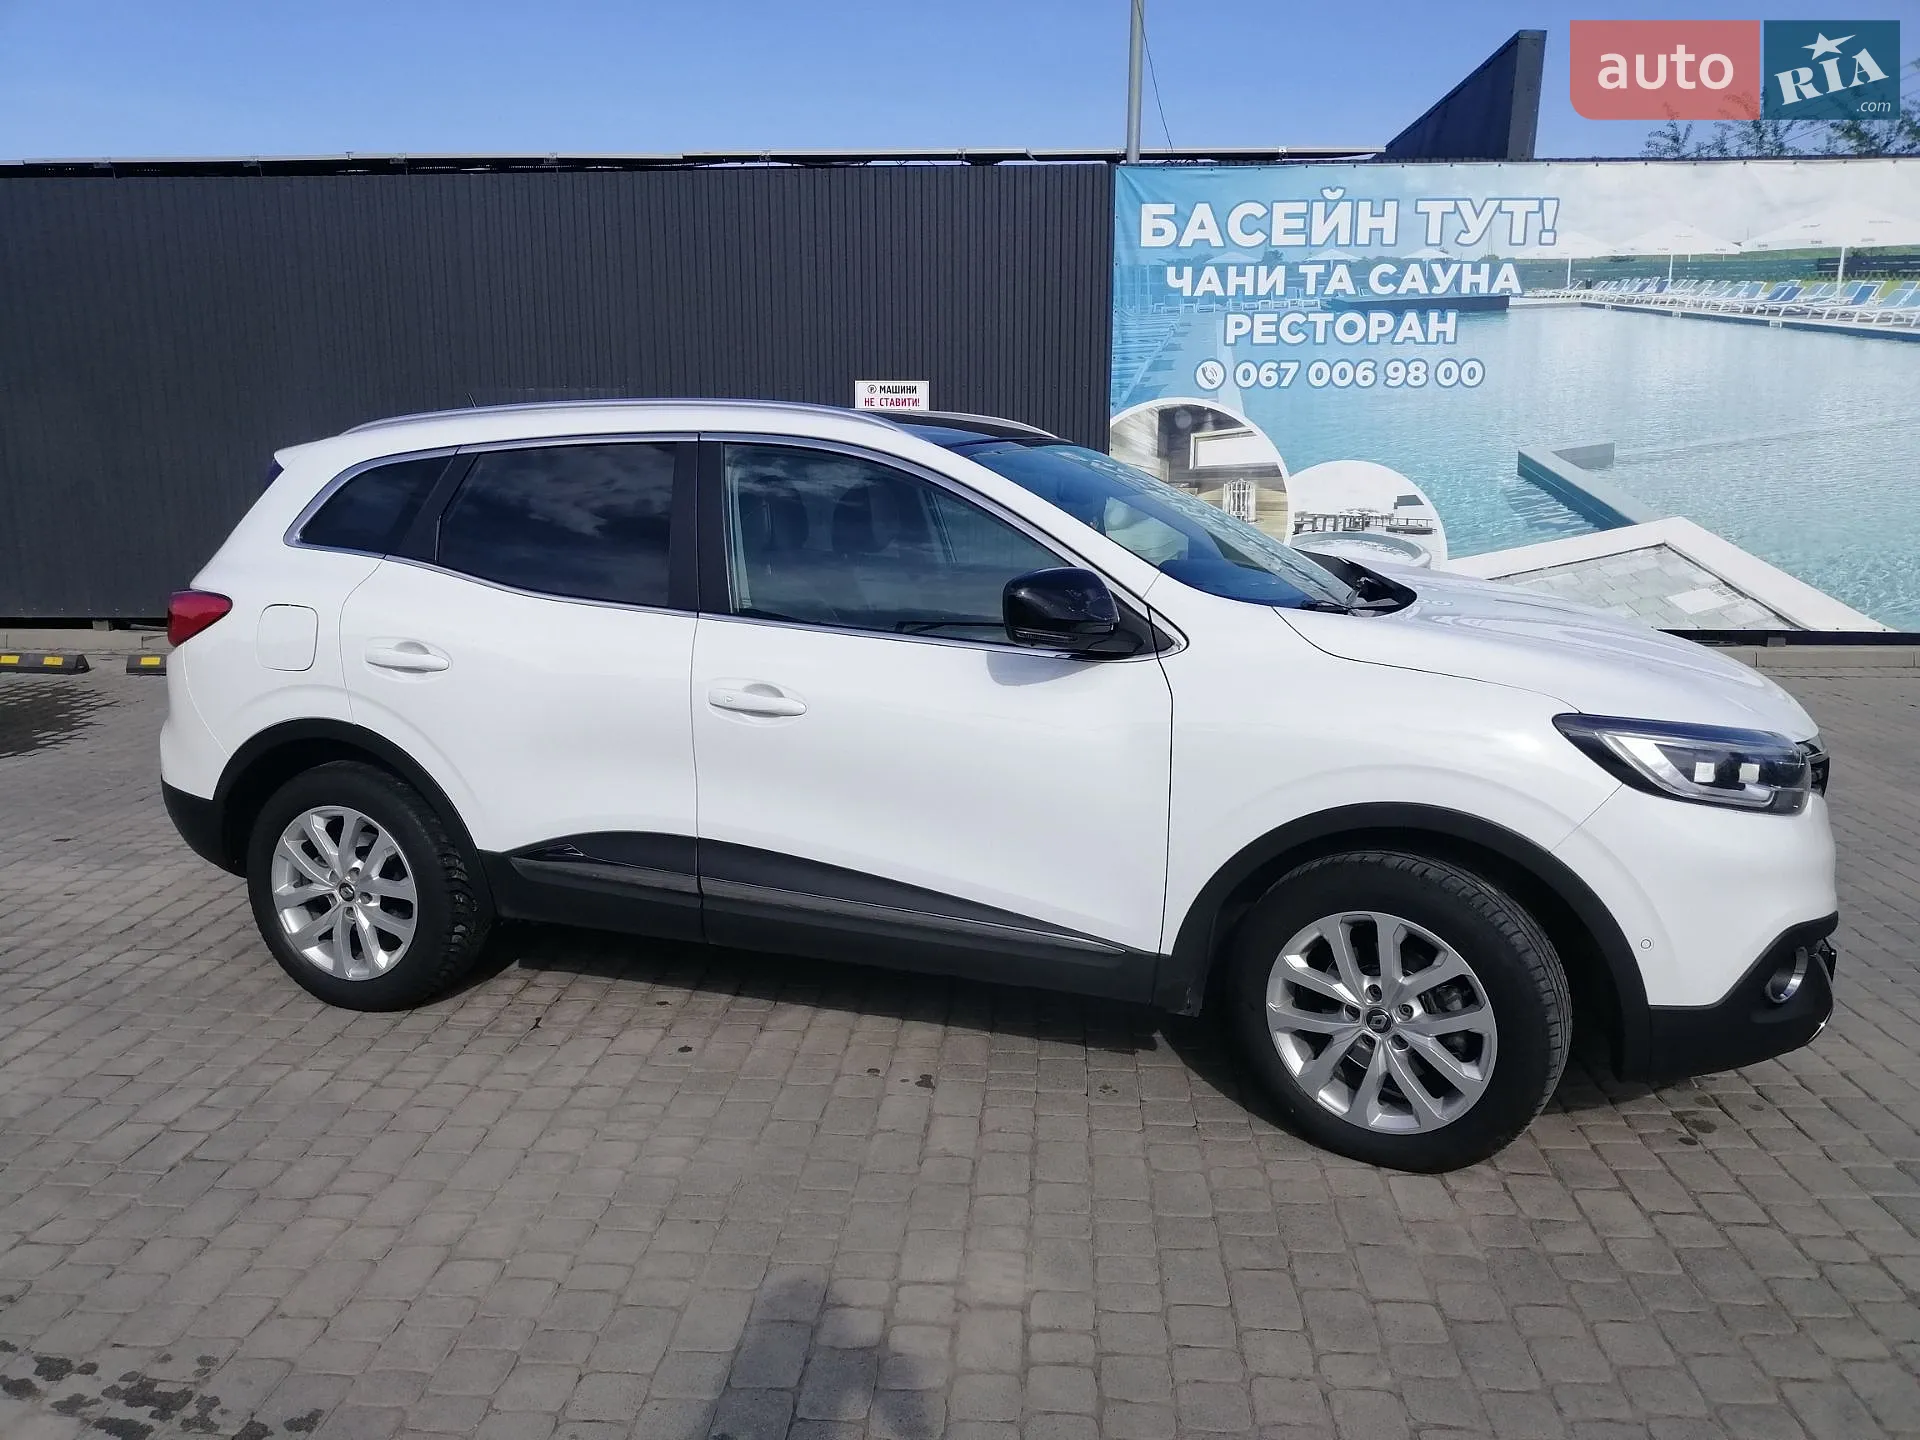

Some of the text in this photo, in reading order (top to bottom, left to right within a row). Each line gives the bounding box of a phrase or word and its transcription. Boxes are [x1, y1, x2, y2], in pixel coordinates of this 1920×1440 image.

[1140, 188, 1559, 247] БАСЕЙН ТУТ!
[1166, 263, 1522, 297] ЧАНИ ТА САУНА
[1224, 312, 1457, 344] РЕСТОРАН
[1235, 361, 1484, 387] 067 006 98 00
[864, 397, 920, 407] НЕ СТАВИТИ!
[879, 385, 917, 395] МАШИНИ
